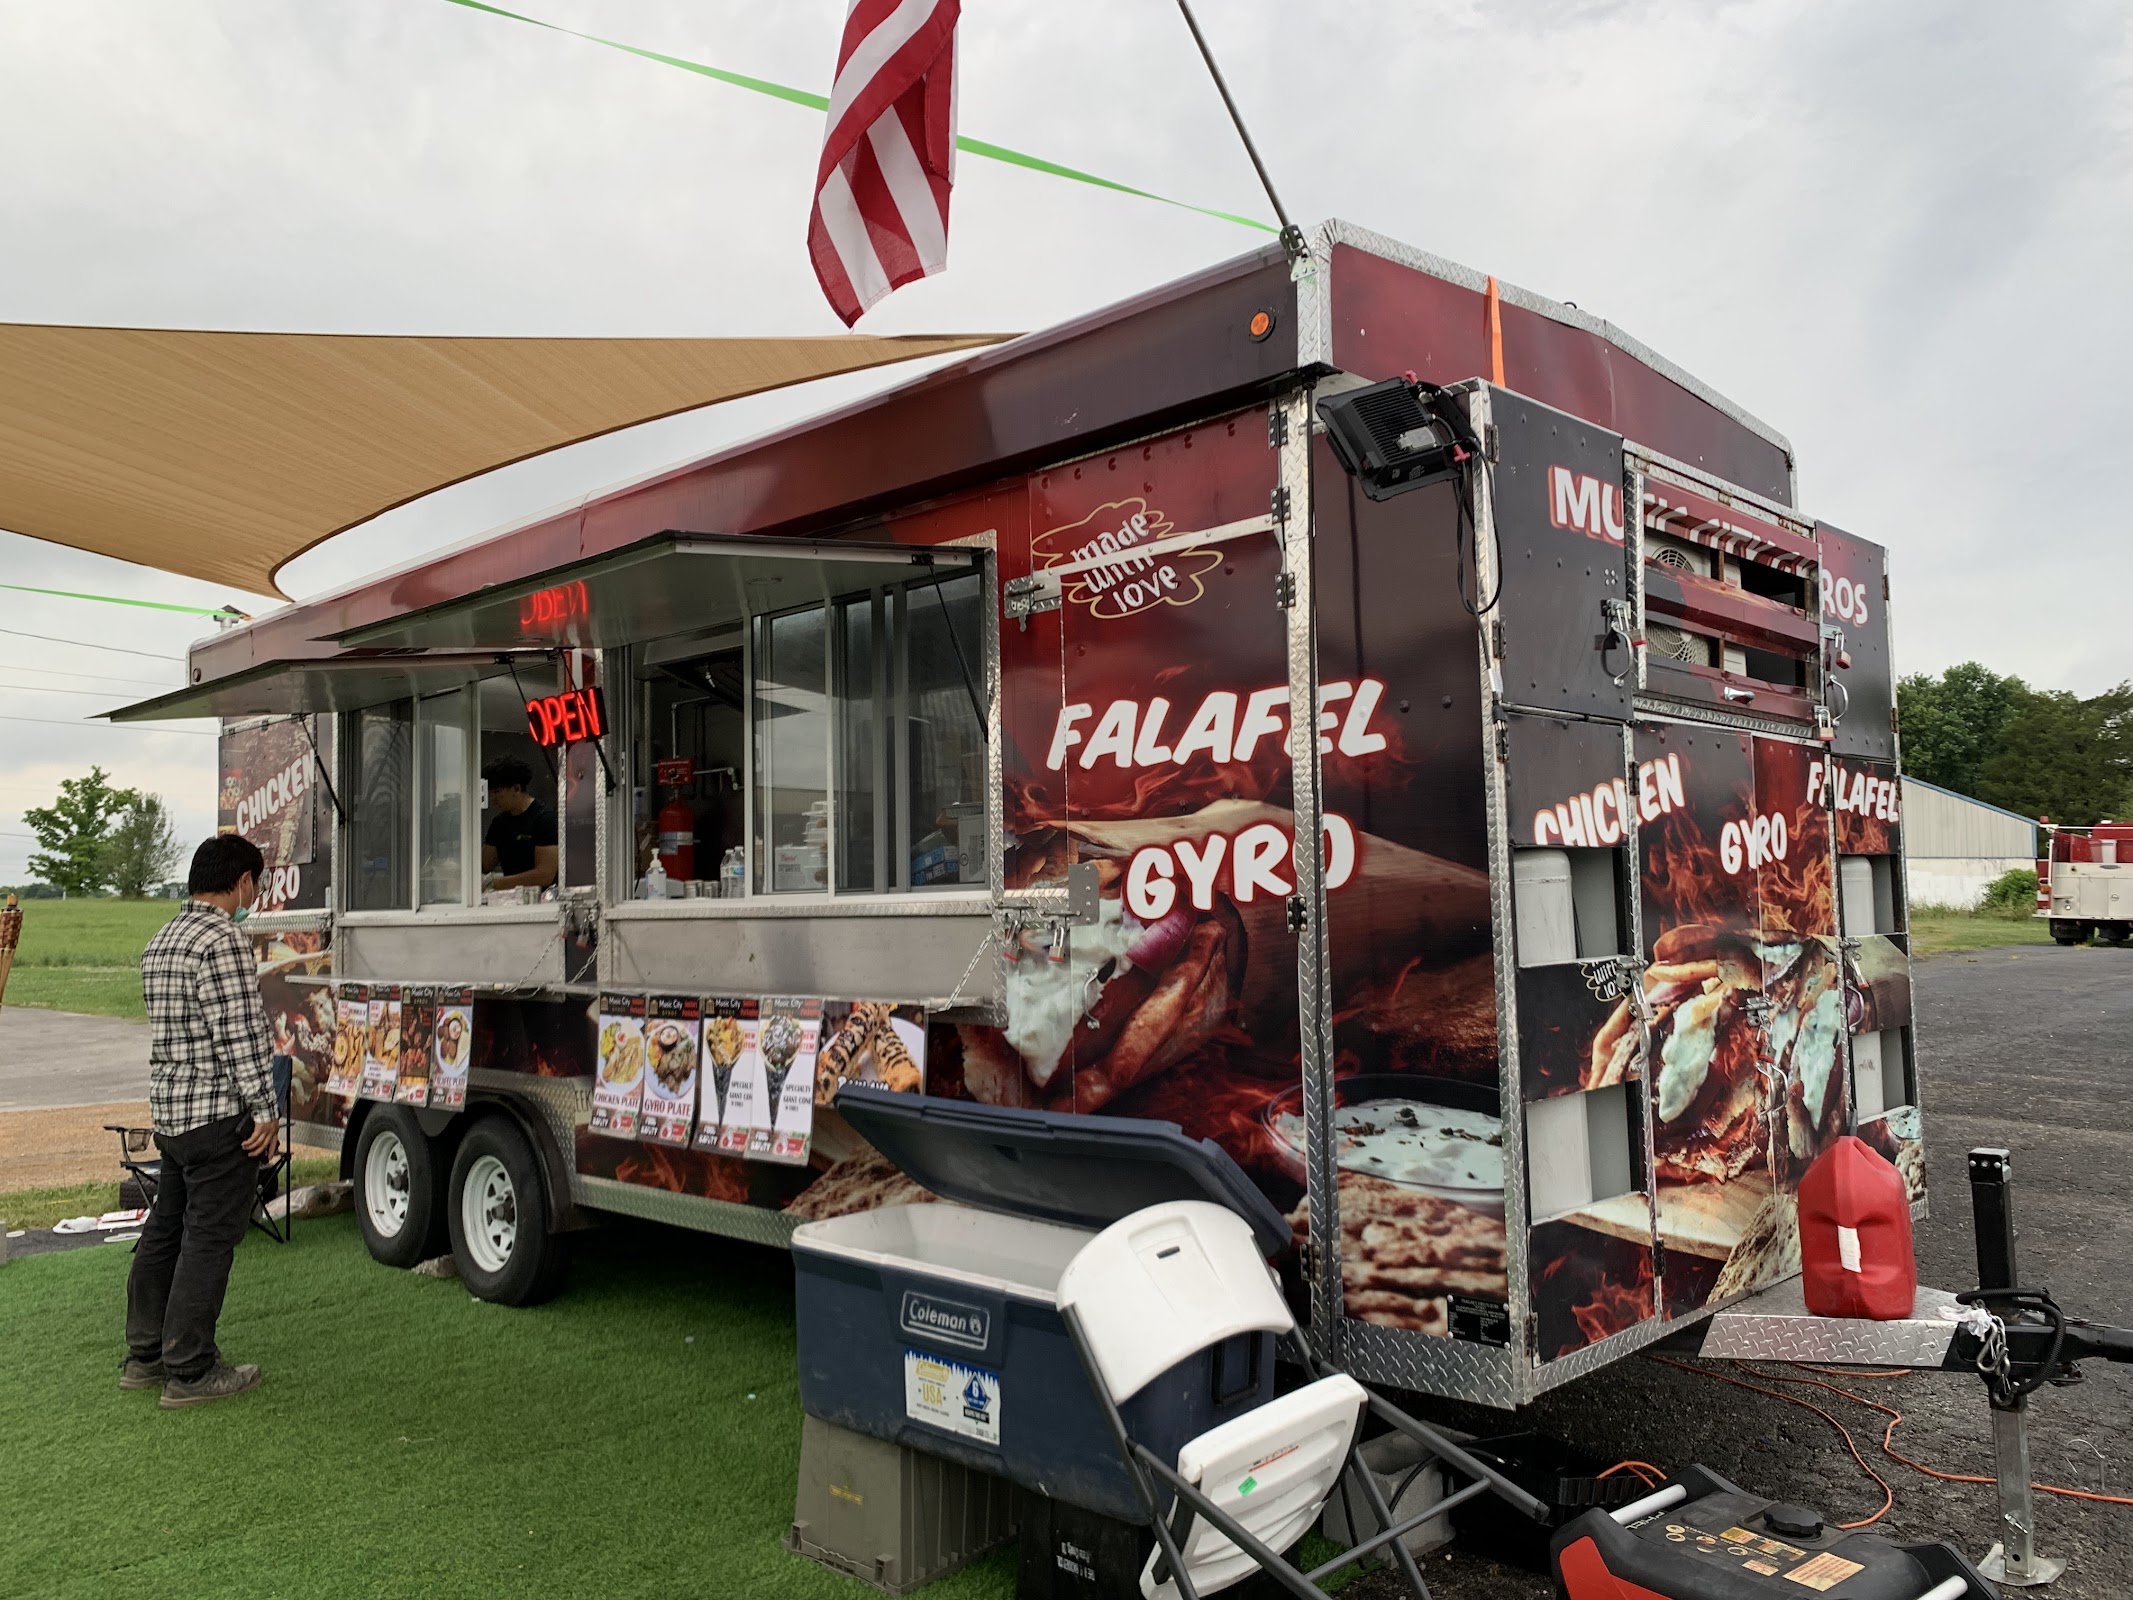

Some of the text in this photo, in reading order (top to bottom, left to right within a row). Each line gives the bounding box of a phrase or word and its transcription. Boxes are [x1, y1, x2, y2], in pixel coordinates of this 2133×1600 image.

[1070, 514, 1149, 562] made
[1113, 565, 1178, 612] love
[526, 688, 601, 747] OPEN
[1046, 679, 1387, 770] FALAFEL
[237, 749, 317, 837] CHICKEN
[1806, 761, 1899, 823] FALAFEL
[1126, 814, 1356, 919] GYRO
[1720, 812, 1787, 874] GYRO
[595, 1093, 639, 1108] CHICKEN PLATE
[644, 1099, 692, 1117] GYRO PLATE
[908, 1300, 967, 1332] Coleman
[922, 1383, 943, 1407] USA
